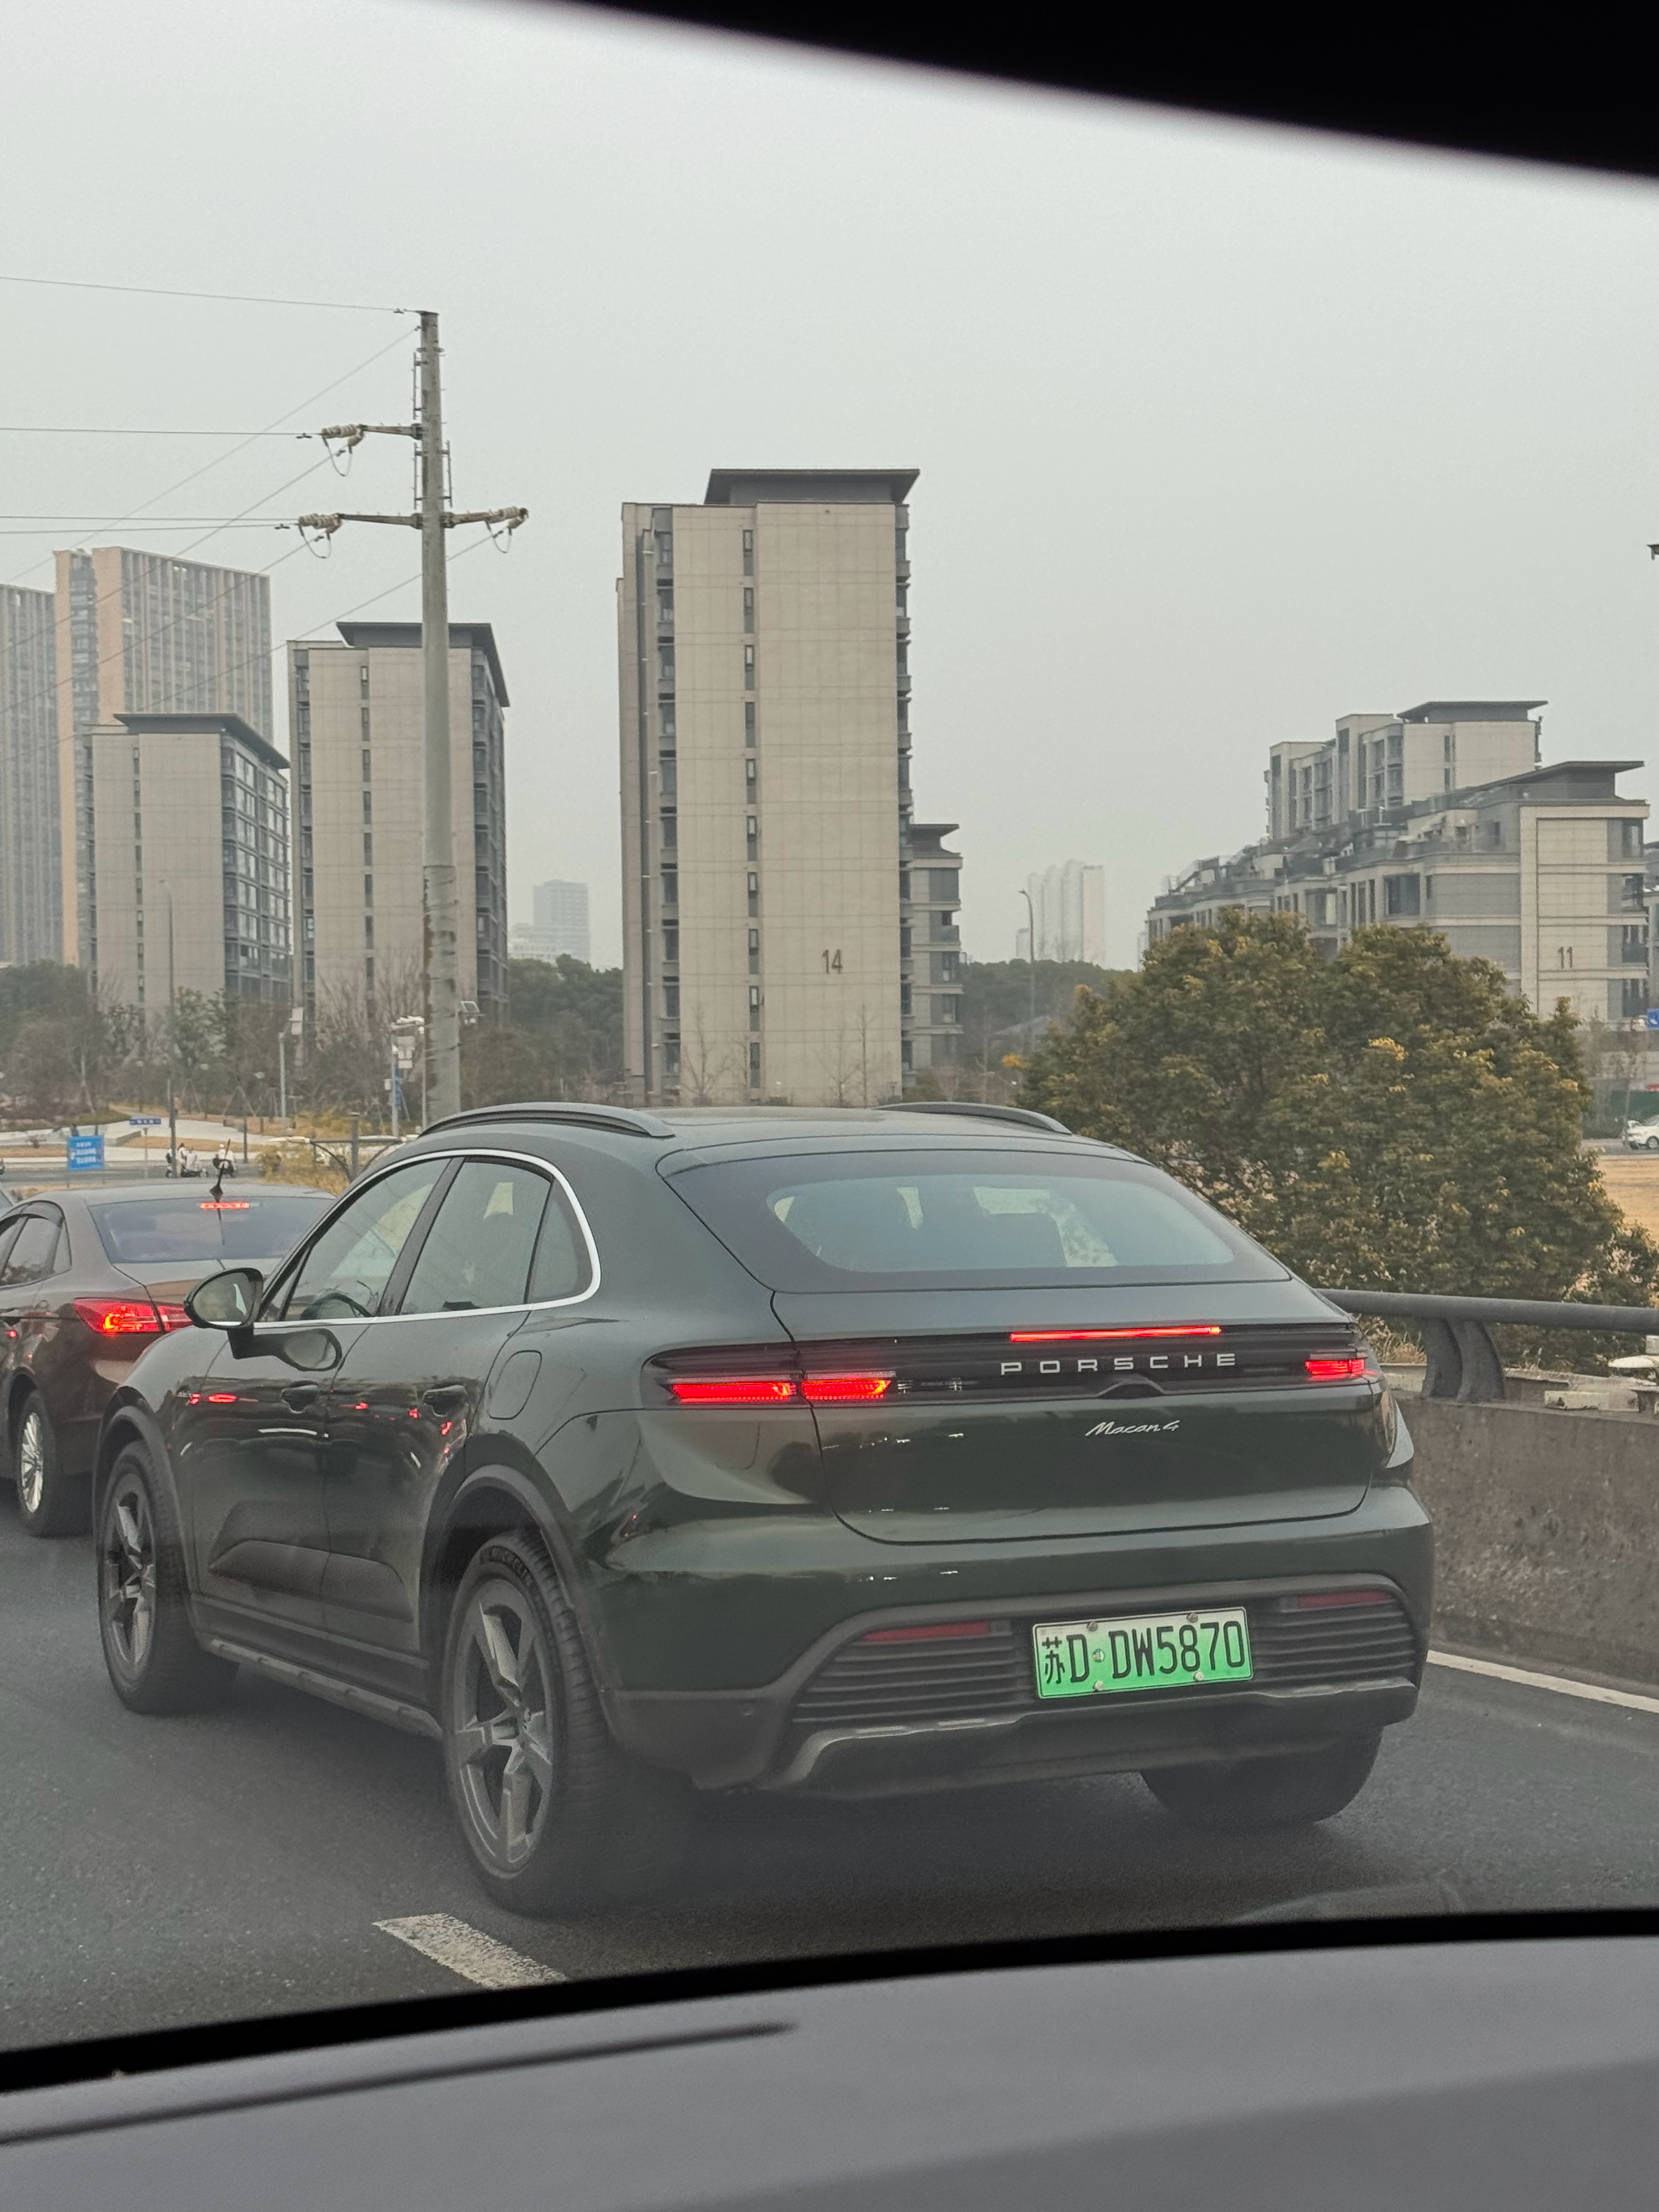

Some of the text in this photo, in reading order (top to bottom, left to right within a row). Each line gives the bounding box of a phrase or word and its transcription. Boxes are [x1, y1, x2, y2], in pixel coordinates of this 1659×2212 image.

[822, 949, 843, 974] 14
[1558, 946, 1573, 969] 11
[1001, 1353, 1235, 1375] PORSCHE
[1085, 1420, 1181, 1436] Macan 4
[1108, 1621, 1245, 1679] DW5870
